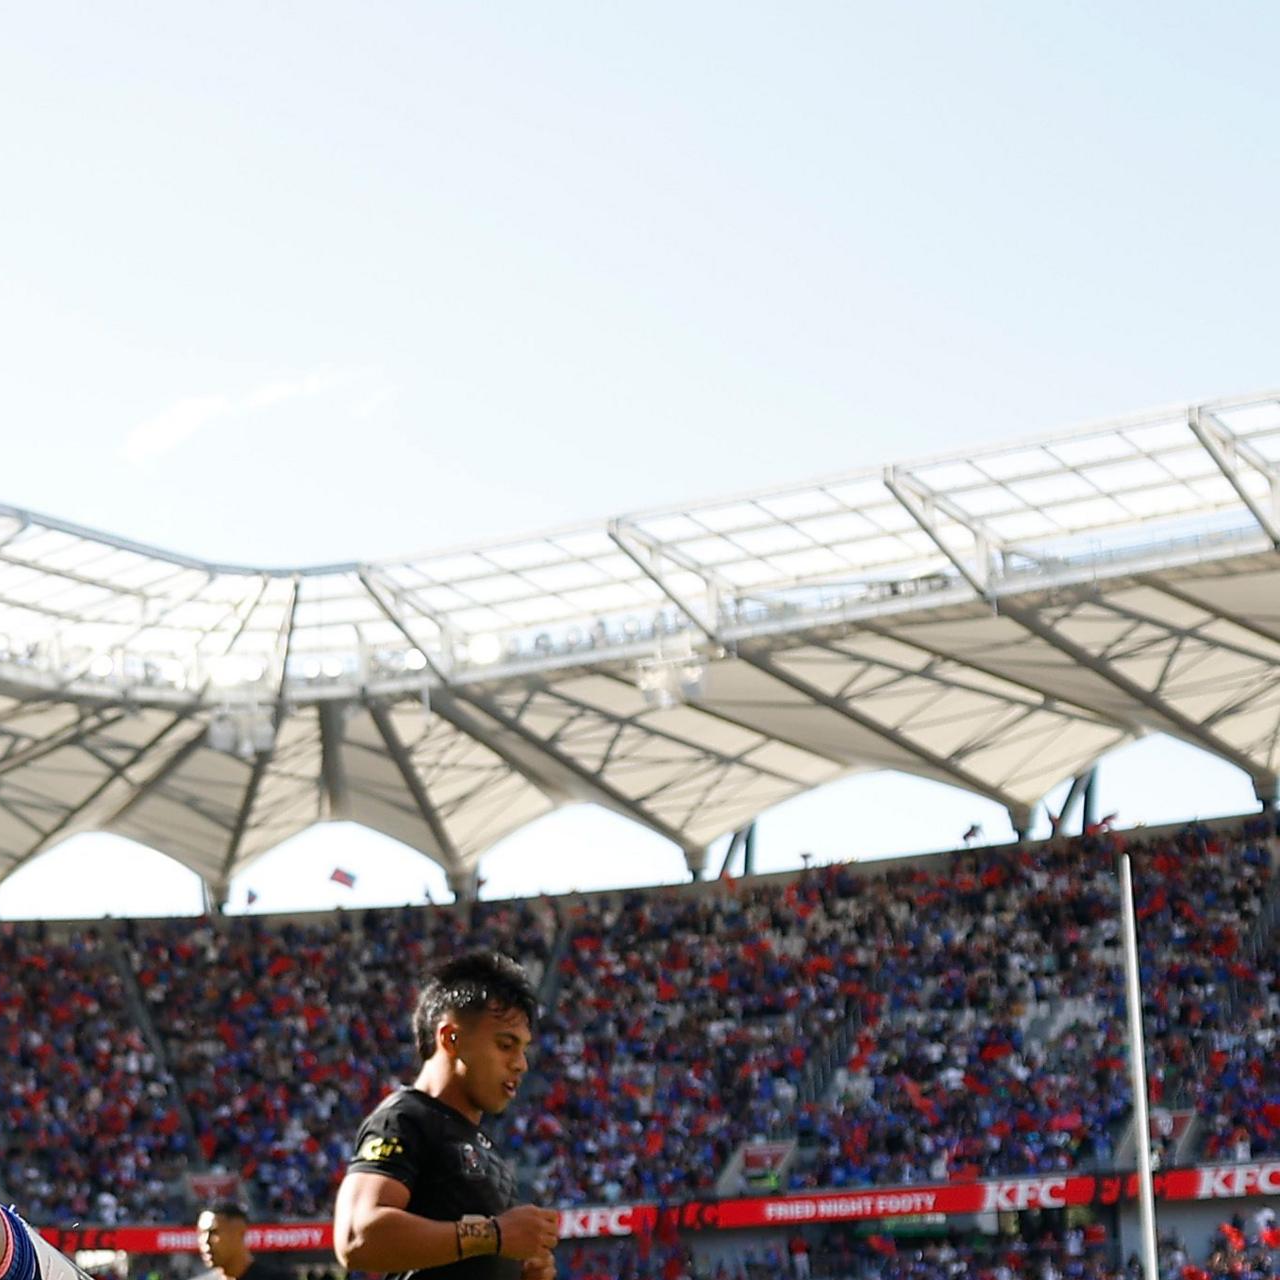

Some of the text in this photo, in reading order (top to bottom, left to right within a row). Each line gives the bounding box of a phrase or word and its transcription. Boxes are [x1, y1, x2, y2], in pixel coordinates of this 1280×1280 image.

[982, 1177, 1067, 1212] KFC
[1198, 1163, 1280, 1199] KFC
[764, 1192, 937, 1221] FRIED NIGHT FOOTY
[263, 1229, 323, 1247] FOOTY
[559, 1206, 633, 1239] KFC
